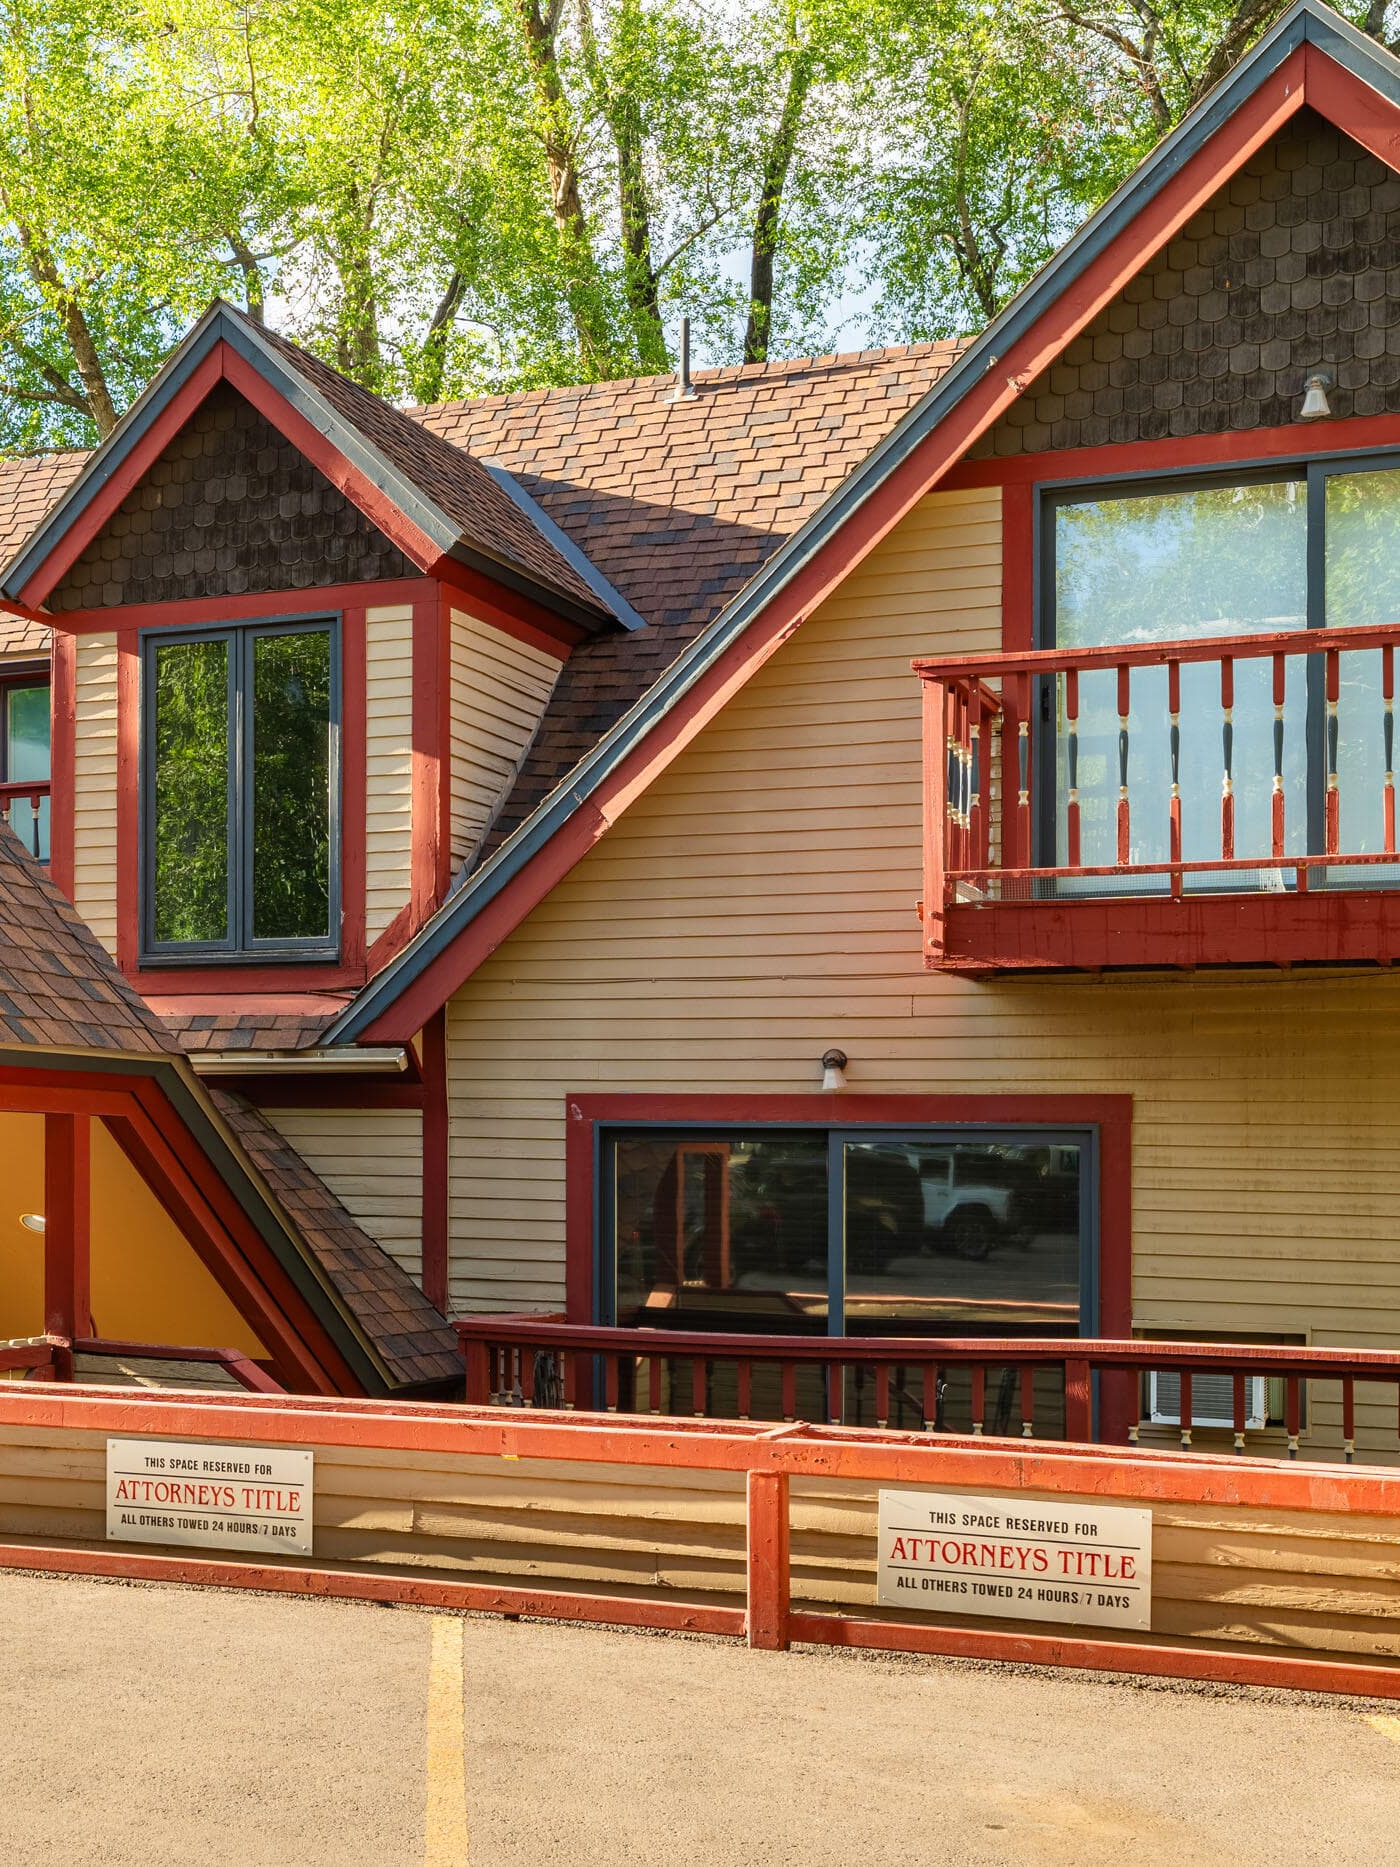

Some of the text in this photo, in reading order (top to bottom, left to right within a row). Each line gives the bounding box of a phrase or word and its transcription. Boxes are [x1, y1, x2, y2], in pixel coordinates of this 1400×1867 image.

[144, 1457, 272, 1475] THIS SPACE RESERVED FOR
[115, 1479, 300, 1512] ATTORNEYS TITLE
[121, 1513, 137, 1525] ALL
[139, 1515, 174, 1528] OTHERS
[177, 1518, 208, 1531] TOWED
[212, 1520, 224, 1532] 24
[272, 1525, 297, 1538] DAYS
[929, 1511, 1098, 1536] THIS SPACE RESERVED FOR
[890, 1537, 1136, 1580] ATTORNEYS TITLE
[897, 1576, 918, 1590] ALL
[922, 1578, 968, 1594] OTHERS
[971, 1582, 1012, 1598] TOWED
[1018, 1587, 1033, 1600] 24
[1097, 1593, 1130, 1609] DAYS
